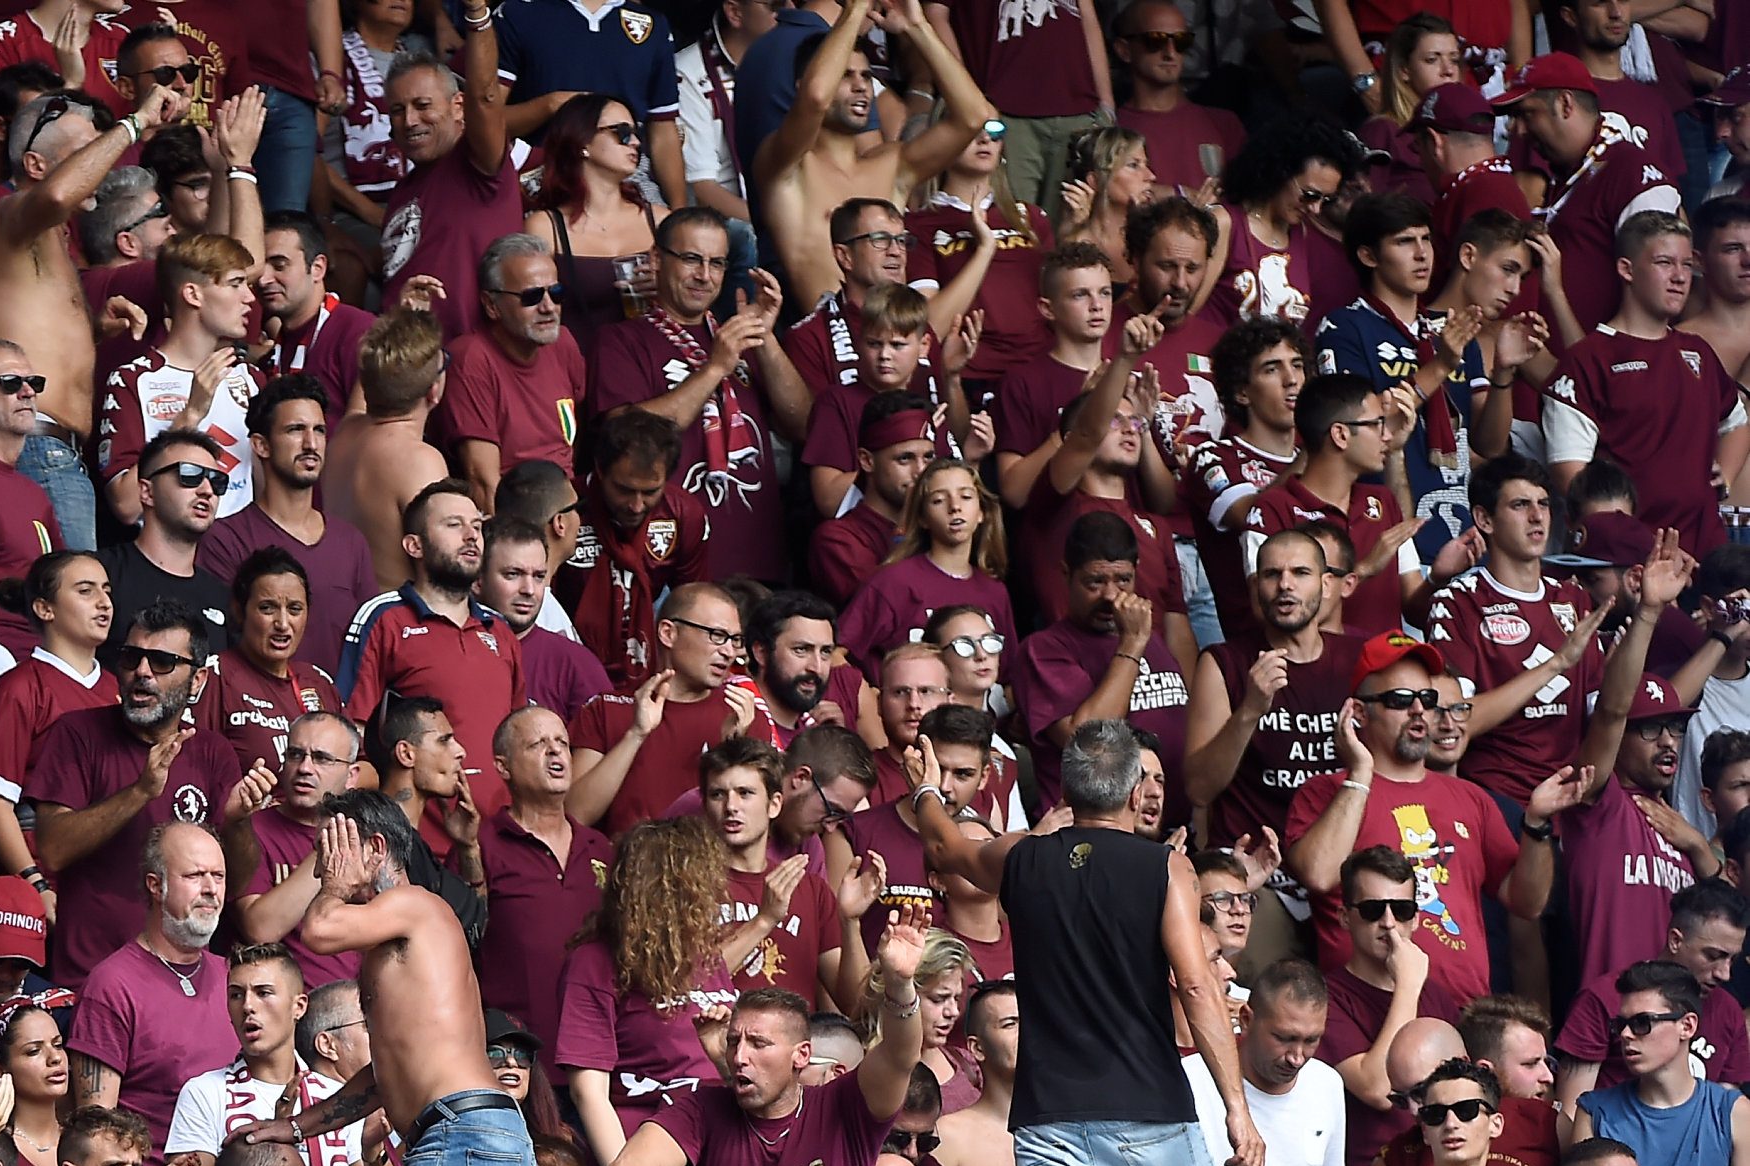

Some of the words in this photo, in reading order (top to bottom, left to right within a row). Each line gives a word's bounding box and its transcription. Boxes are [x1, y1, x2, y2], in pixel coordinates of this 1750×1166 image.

[1258, 707, 1292, 731] MÈ
[1289, 741, 1305, 761] A
[1623, 854, 1649, 885] LA
[890, 885, 933, 899] SUZUKI
